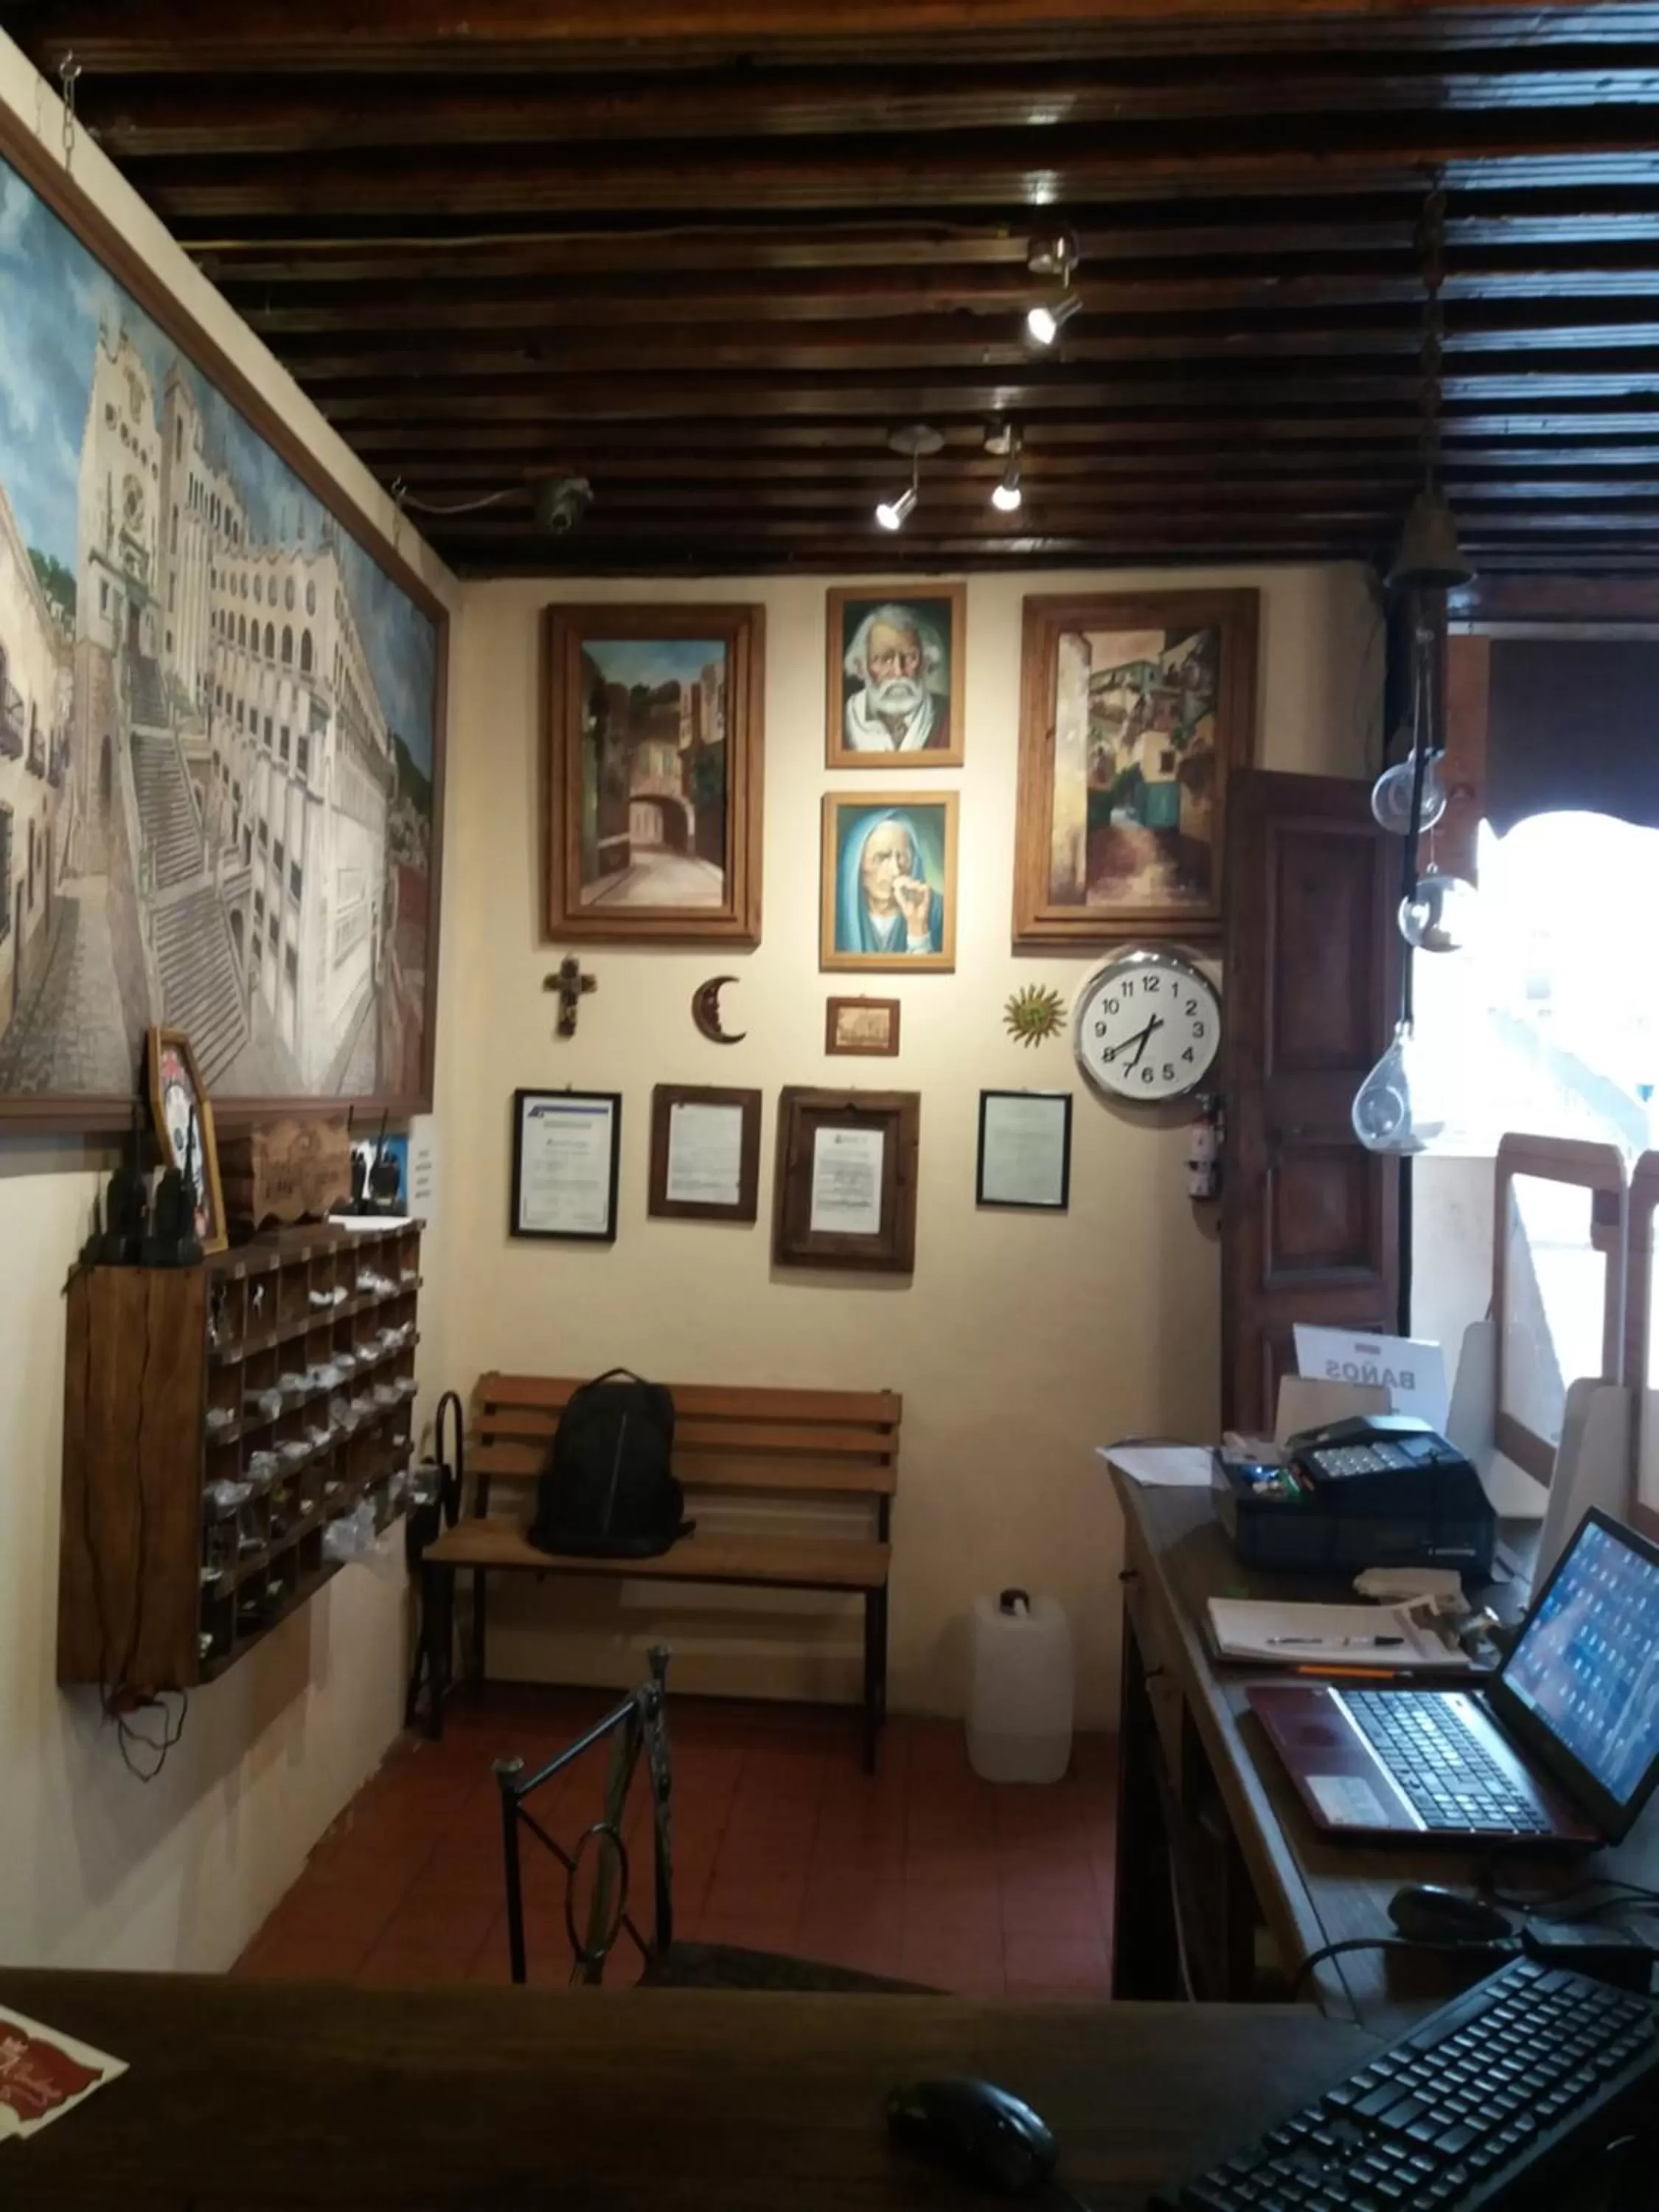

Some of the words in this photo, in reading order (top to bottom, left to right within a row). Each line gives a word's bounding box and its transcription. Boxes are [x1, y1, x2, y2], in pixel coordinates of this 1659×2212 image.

[1121, 981, 1133, 996] 11
[1142, 975, 1160, 992] 12
[1171, 982, 1178, 998] 1
[1102, 999, 1119, 1015] 10
[1186, 1000, 1197, 1016] 2
[1095, 1021, 1106, 1037] 9
[1192, 1021, 1204, 1038] 3
[1102, 1047, 1115, 1062] 8
[1182, 1047, 1194, 1062] 4
[1122, 1062, 1135, 1078] 7
[1141, 1068, 1154, 1083] 6
[1163, 1064, 1175, 1080] 5
